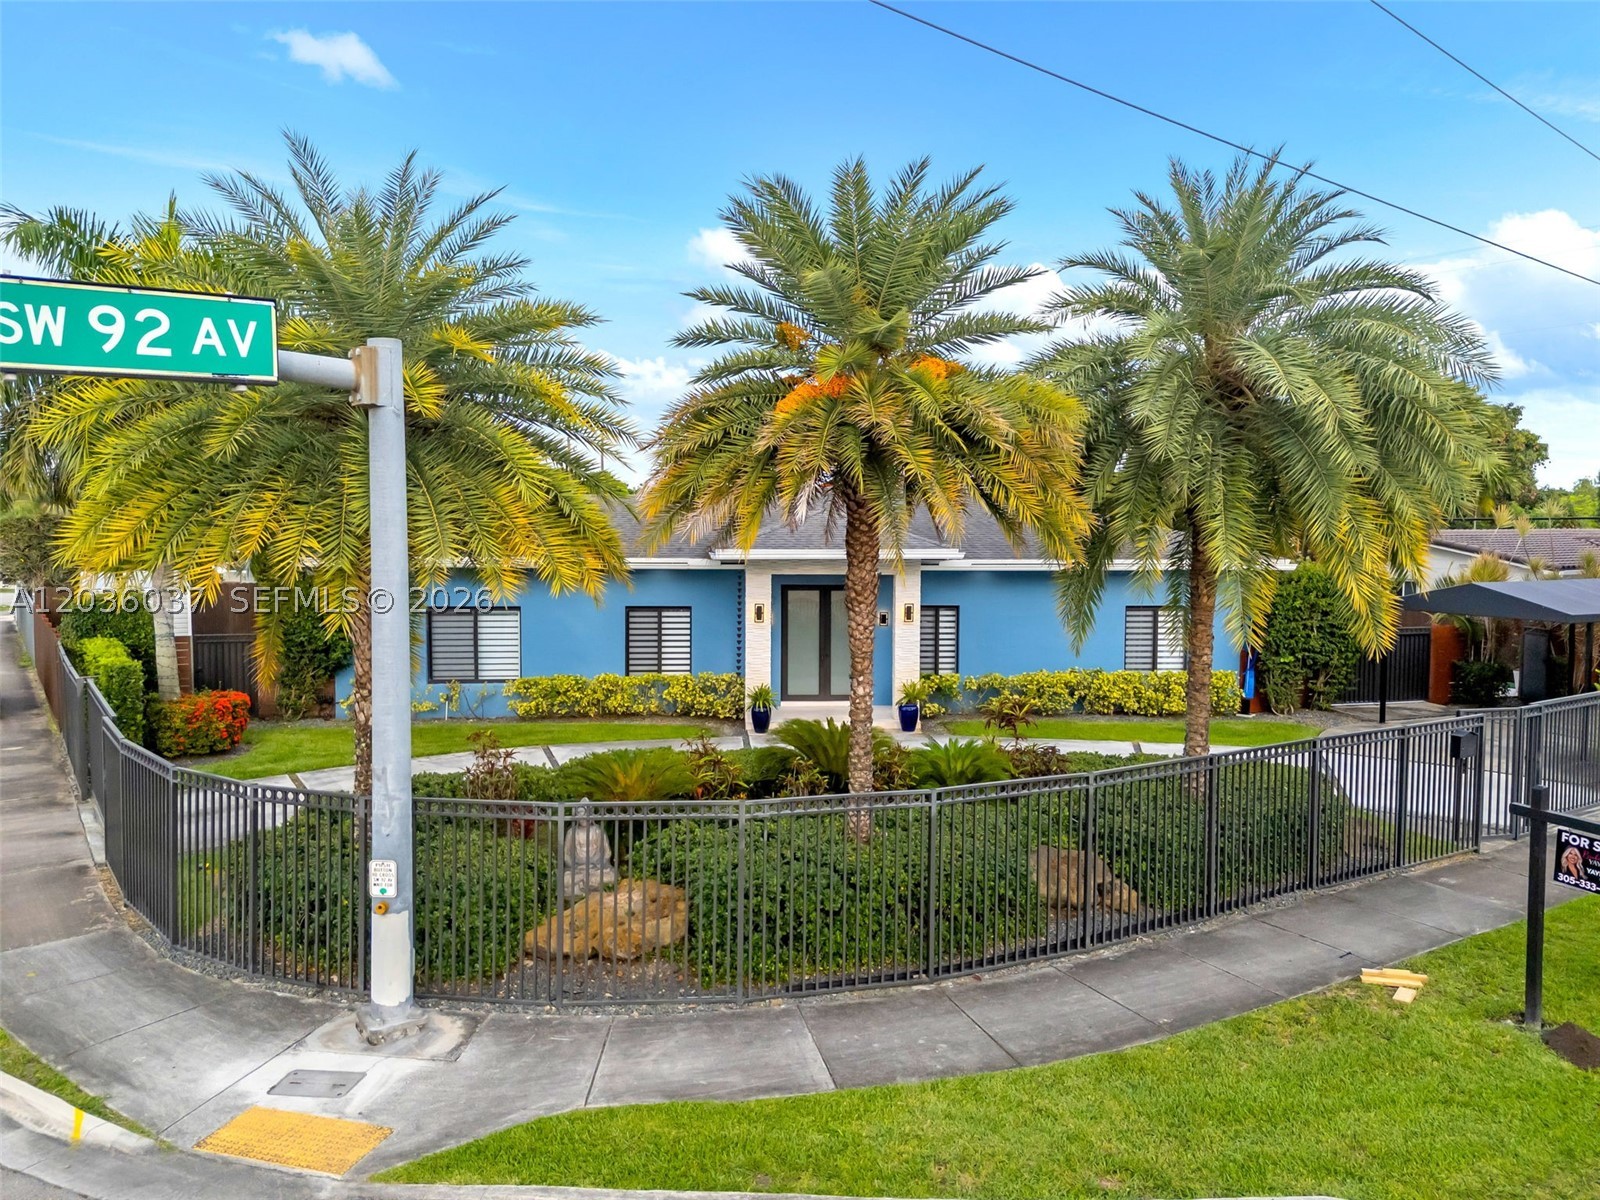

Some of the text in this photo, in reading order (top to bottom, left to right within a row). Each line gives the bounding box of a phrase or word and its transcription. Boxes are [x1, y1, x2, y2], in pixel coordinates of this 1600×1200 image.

[0, 301, 257, 358] SW 92 AV
[1561, 832, 1590, 849] FOR
